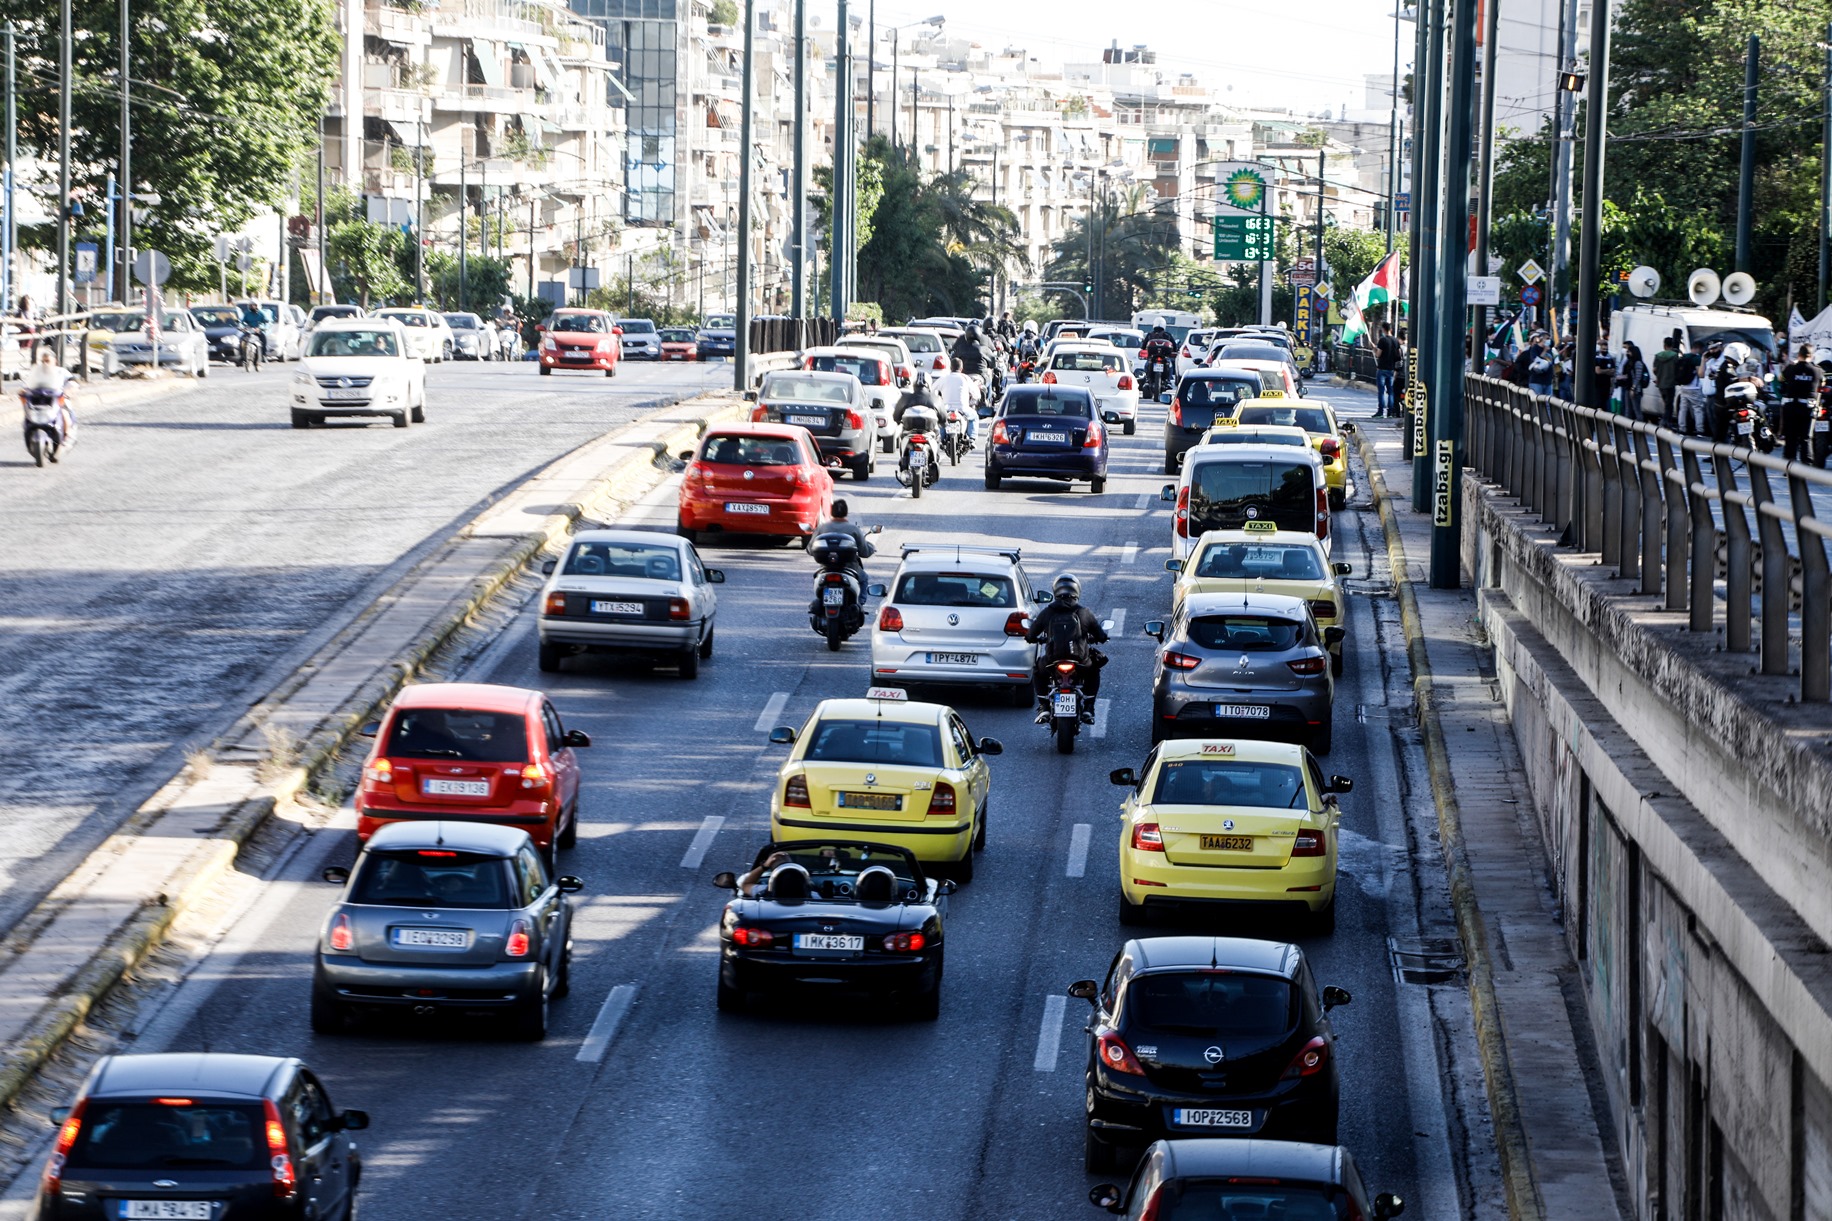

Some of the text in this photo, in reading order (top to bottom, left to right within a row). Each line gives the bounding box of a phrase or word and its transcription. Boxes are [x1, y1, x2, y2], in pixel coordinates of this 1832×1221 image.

[1415, 384, 1427, 454] tzaba.gr
[1436, 440, 1452, 524] tzaba.gr
[873, 690, 901, 698] TAXI
[1060, 704, 1076, 713] 705
[1203, 745, 1233, 753] TAXI
